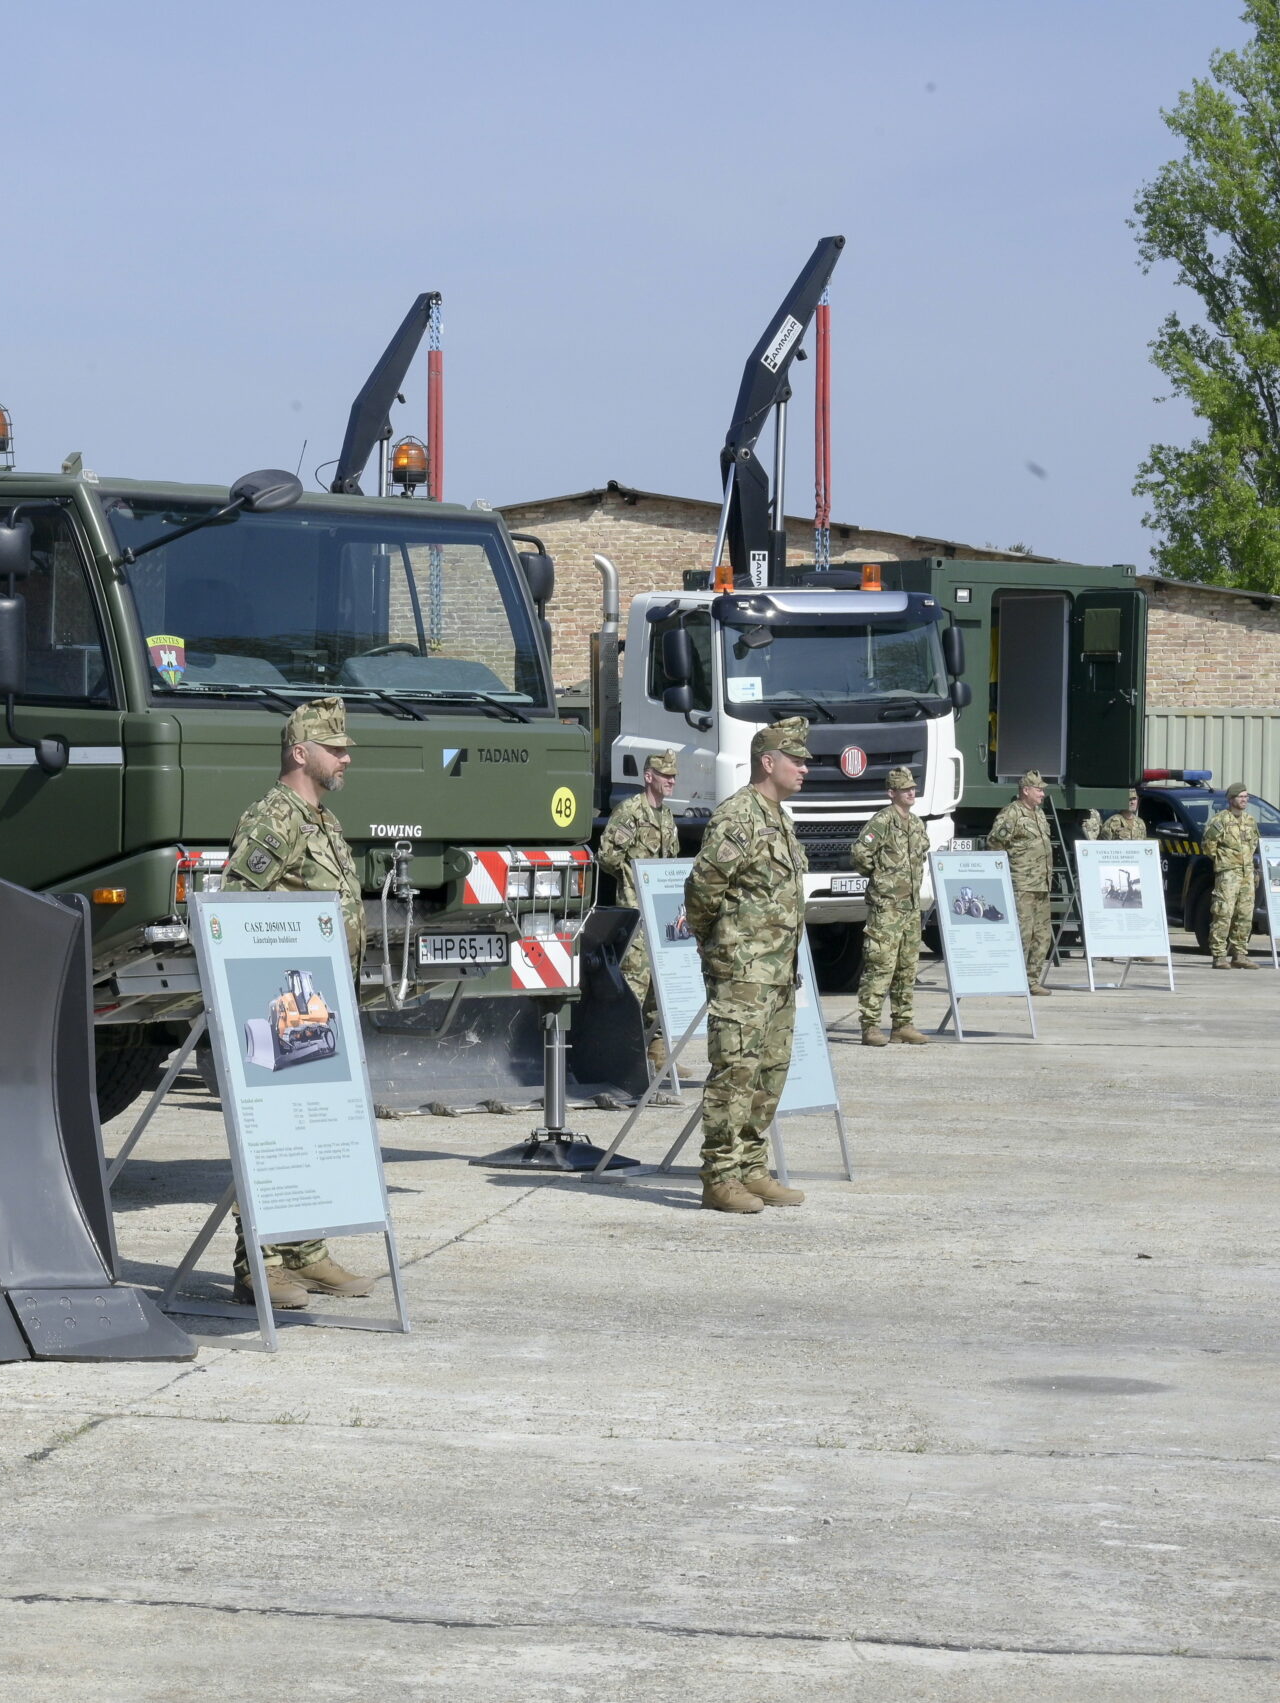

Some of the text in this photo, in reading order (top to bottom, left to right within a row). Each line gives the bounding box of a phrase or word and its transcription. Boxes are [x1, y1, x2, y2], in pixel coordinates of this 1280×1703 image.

[763, 320, 798, 370] HAMMAR
[151, 636, 180, 645] SZENTES
[477, 748, 529, 763] TADANO
[555, 797, 572, 818] 48
[369, 824, 422, 838] TOWING
[952, 840, 972, 850] 2-66
[840, 879, 853, 891] HT
[244, 921, 302, 933] CASE 2050M XLT
[432, 937, 504, 960] HP 65-13
